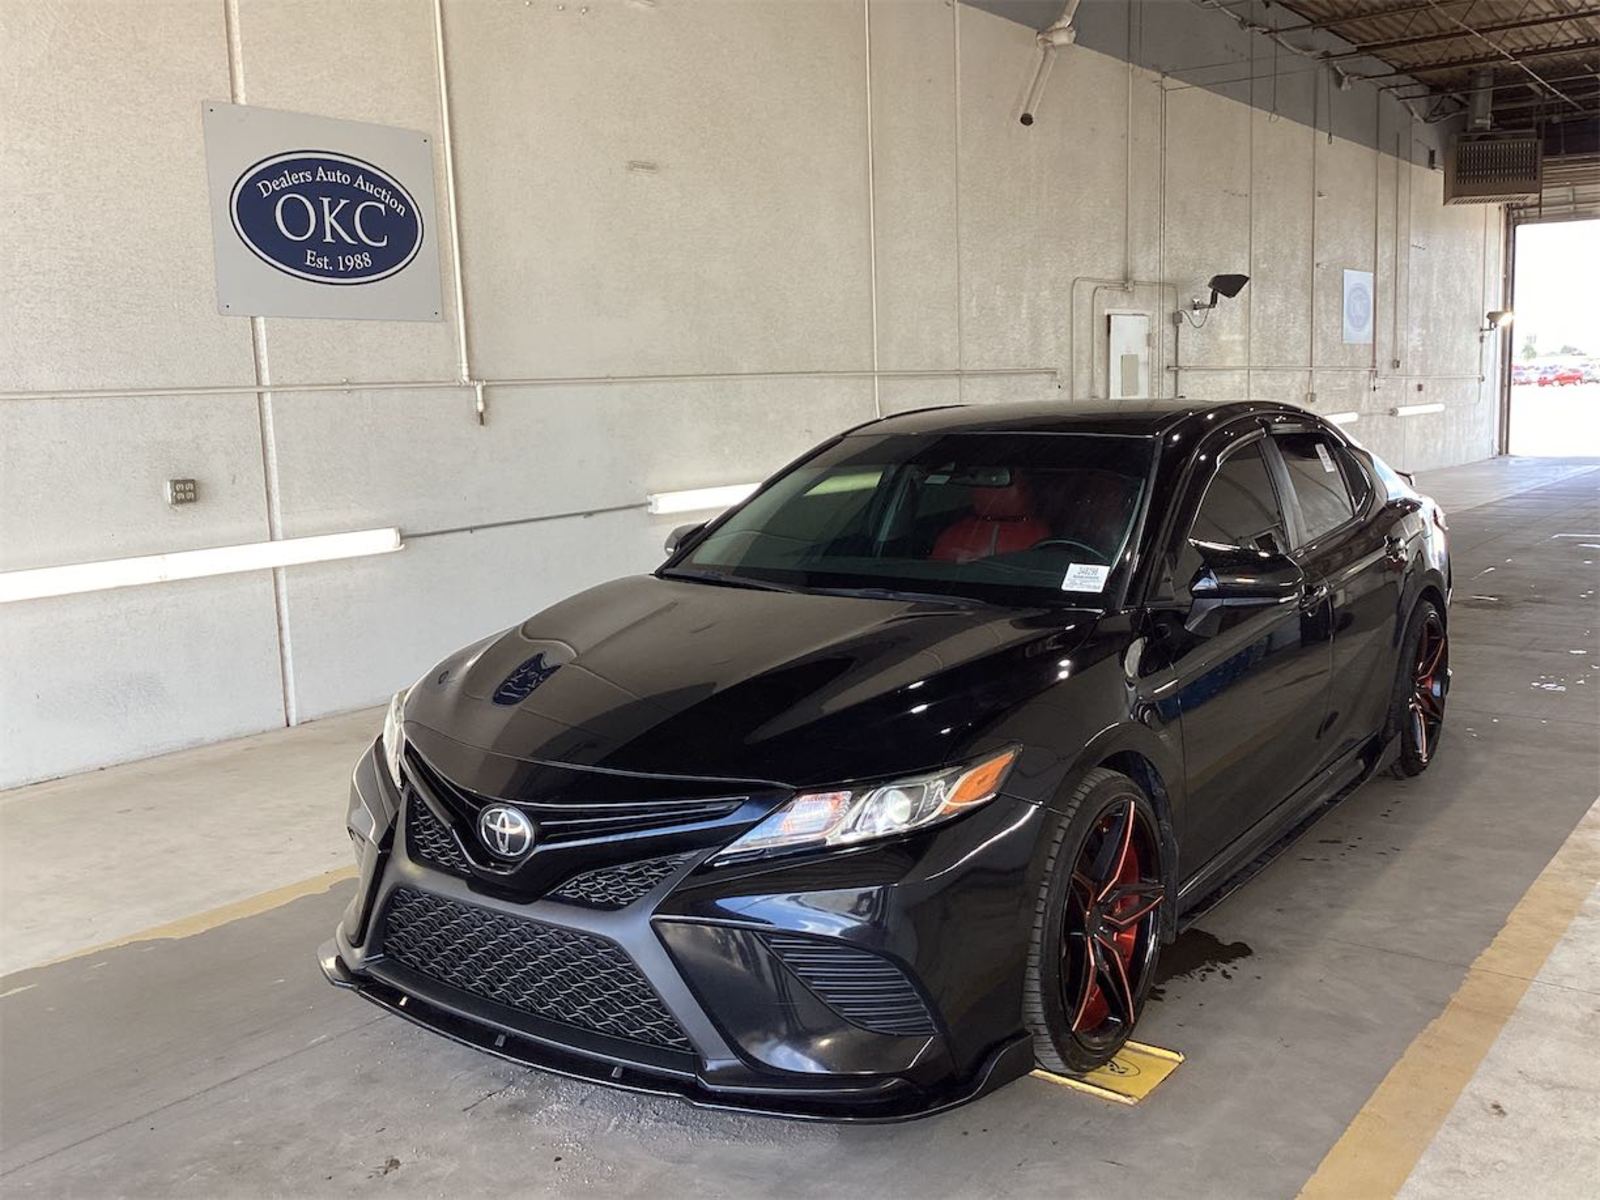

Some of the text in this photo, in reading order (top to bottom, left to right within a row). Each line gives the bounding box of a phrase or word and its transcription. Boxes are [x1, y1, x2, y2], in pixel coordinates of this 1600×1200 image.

[257, 167, 406, 217] Dealers Auto Auction
[275, 194, 388, 247] OKC
[305, 250, 372, 272] Est. 1988
